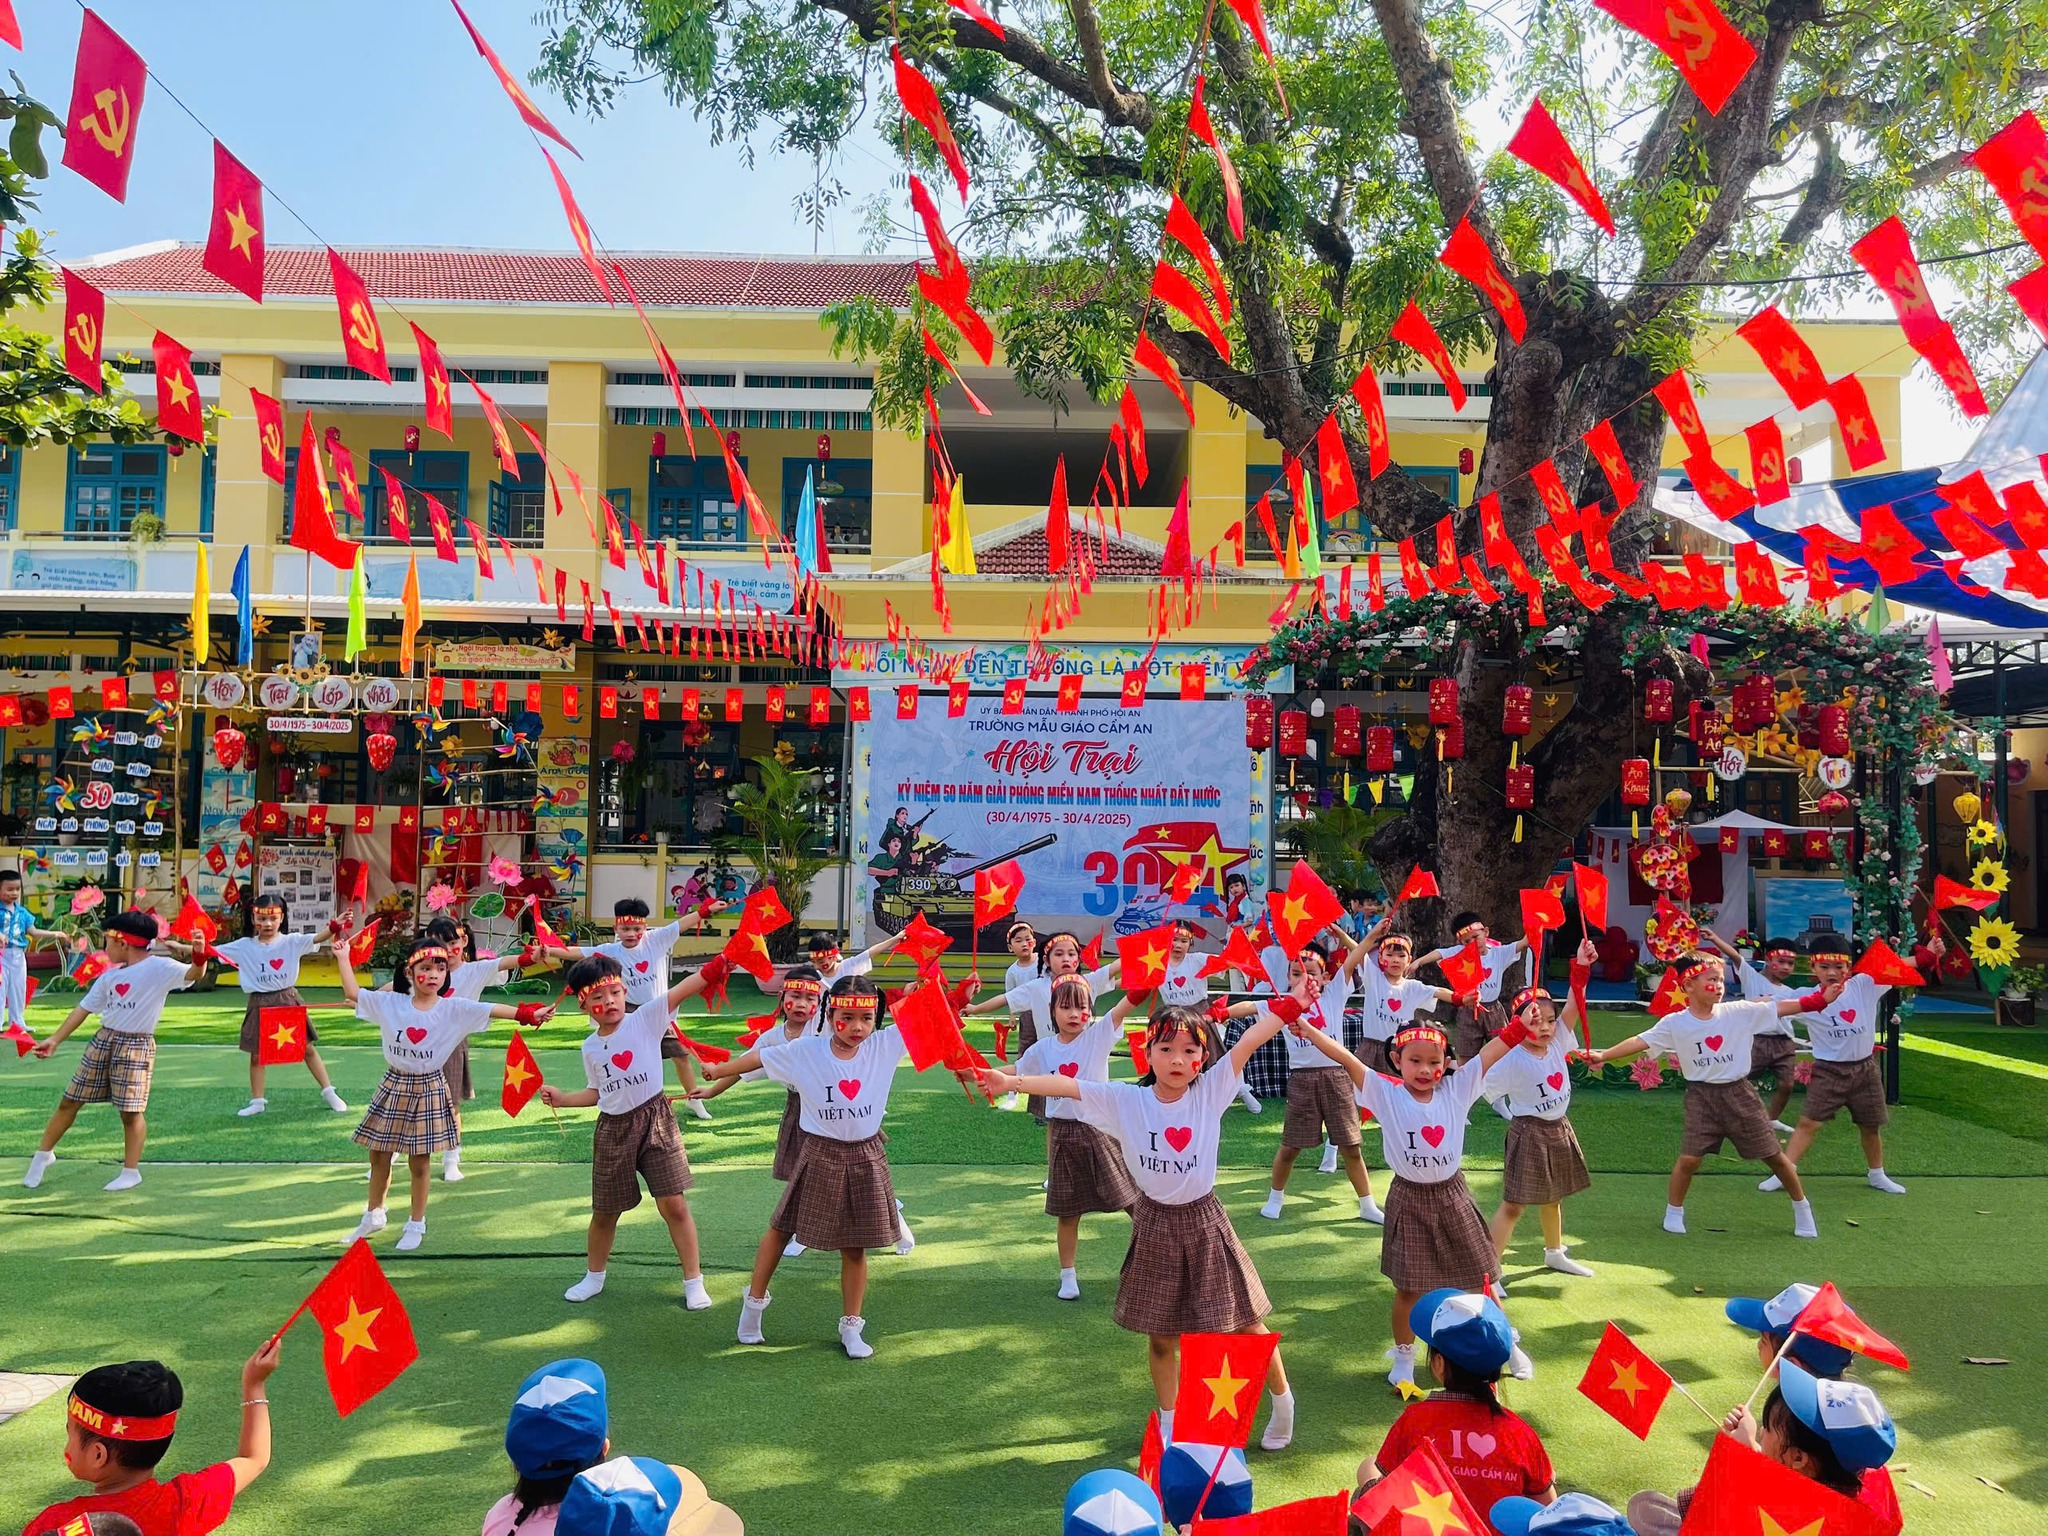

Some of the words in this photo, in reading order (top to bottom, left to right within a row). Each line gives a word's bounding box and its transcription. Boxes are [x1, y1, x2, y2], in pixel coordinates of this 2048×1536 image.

[741, 578, 758, 587] biết
[458, 644, 475, 653] Ngôi
[964, 650, 1004, 674] ĐẾN
[1012, 655, 1092, 676] TRỜNG
[1100, 656, 1125, 676] LÀ
[1180, 655, 1227, 677] ỀM
[318, 683, 344, 708] Lớp
[1128, 709, 1141, 717] AN
[968, 717, 1025, 733] TRƯỜNG
[1028, 716, 1057, 733] MẪU
[1060, 720, 1095, 734] GIÁO
[1098, 718, 1130, 734] CẨM
[1133, 723, 1152, 734] AN
[983, 739, 1058, 777] Hội
[1061, 739, 1143, 779] Trại
[81, 781, 114, 809] 50
[897, 777, 912, 802] KỶ
[914, 780, 941, 807] NIỆM
[943, 784, 957, 803] 50
[958, 780, 983, 804] NĂM
[985, 779, 1007, 804] GIẢI
[1009, 782, 1044, 805] PHÓNG
[1047, 780, 1074, 806] MIỀN
[1076, 786, 1101, 806] NAM
[1103, 781, 1138, 806] THỐNG
[1140, 781, 1167, 807] NHẤT
[1169, 782, 1190, 808] ĐẤT
[1192, 785, 1221, 808] NƯỚC
[986, 811, 1051, 825] (30/4/1975
[1062, 812, 1132, 828] 30/4/2025)
[145, 823, 162, 834] NAM
[908, 879, 931, 891] 390
[1830, 1015, 1839, 1027] I
[409, 1049, 434, 1061] NAM
[1695, 1041, 1703, 1055] I
[1713, 1053, 1735, 1065] NAM
[602, 1062, 612, 1079] I
[624, 1072, 648, 1088] NAM
[825, 1085, 834, 1103] I
[1536, 1082, 1547, 1099] I
[818, 1105, 845, 1123] VIỆT
[848, 1104, 873, 1118] NAM
[1149, 1131, 1158, 1152] I
[1406, 1131, 1417, 1150] I
[1139, 1154, 1170, 1175] VIỆT
[1450, 1429, 1464, 1459] I
[1452, 1466, 1479, 1477] GIÁO
[1504, 1472, 1518, 1482] AN
